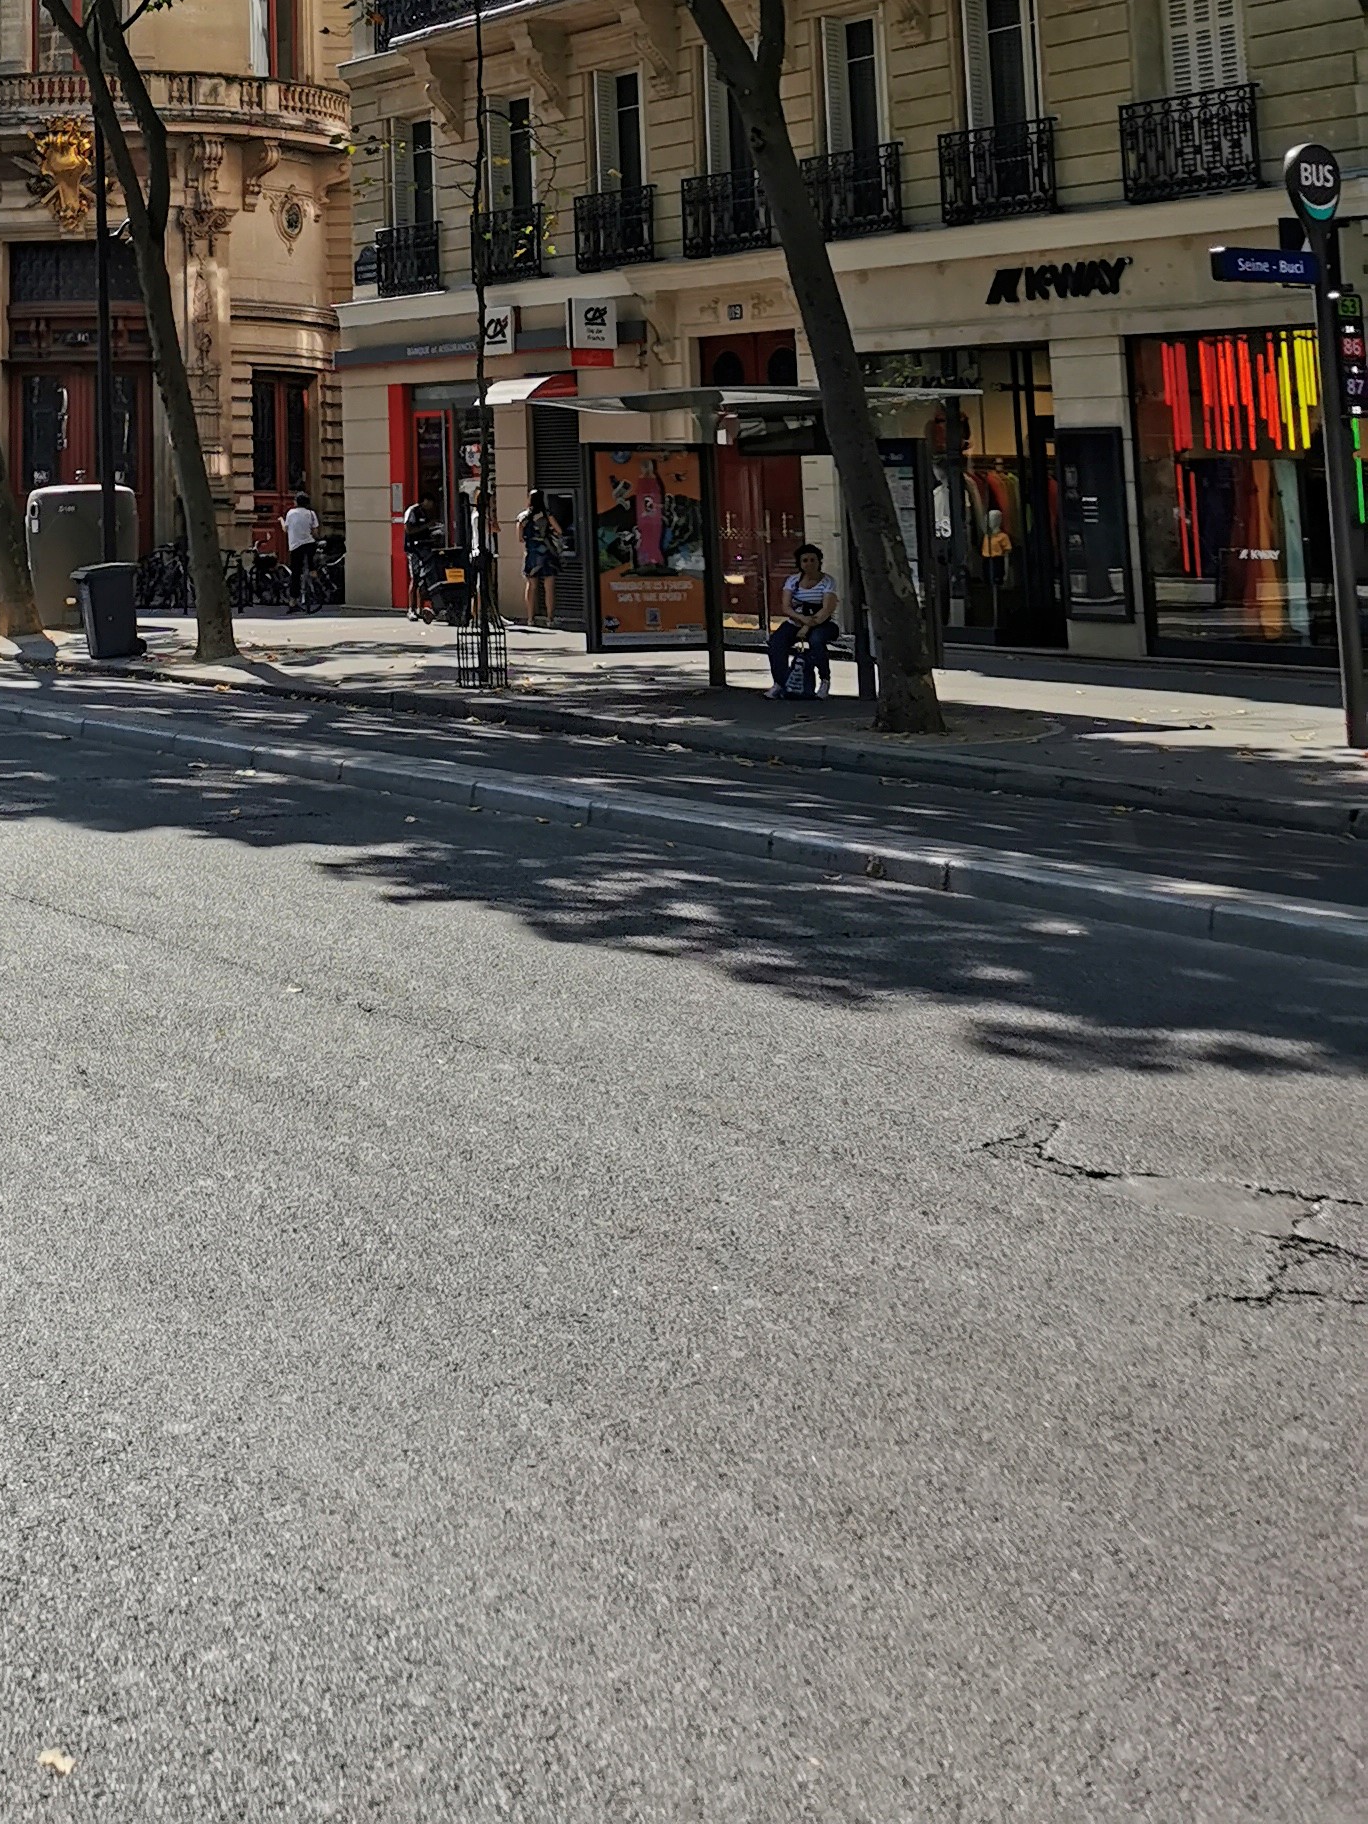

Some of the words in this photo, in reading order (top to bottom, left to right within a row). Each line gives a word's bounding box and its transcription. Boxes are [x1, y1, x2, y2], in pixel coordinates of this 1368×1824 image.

[1300, 162, 1334, 188] BUS
[1237, 258, 1270, 273] Seine
[1279, 259, 1305, 274] Buci
[1341, 298, 1358, 314] 63
[1343, 337, 1362, 356] 86
[1346, 378, 1365, 396] 87
